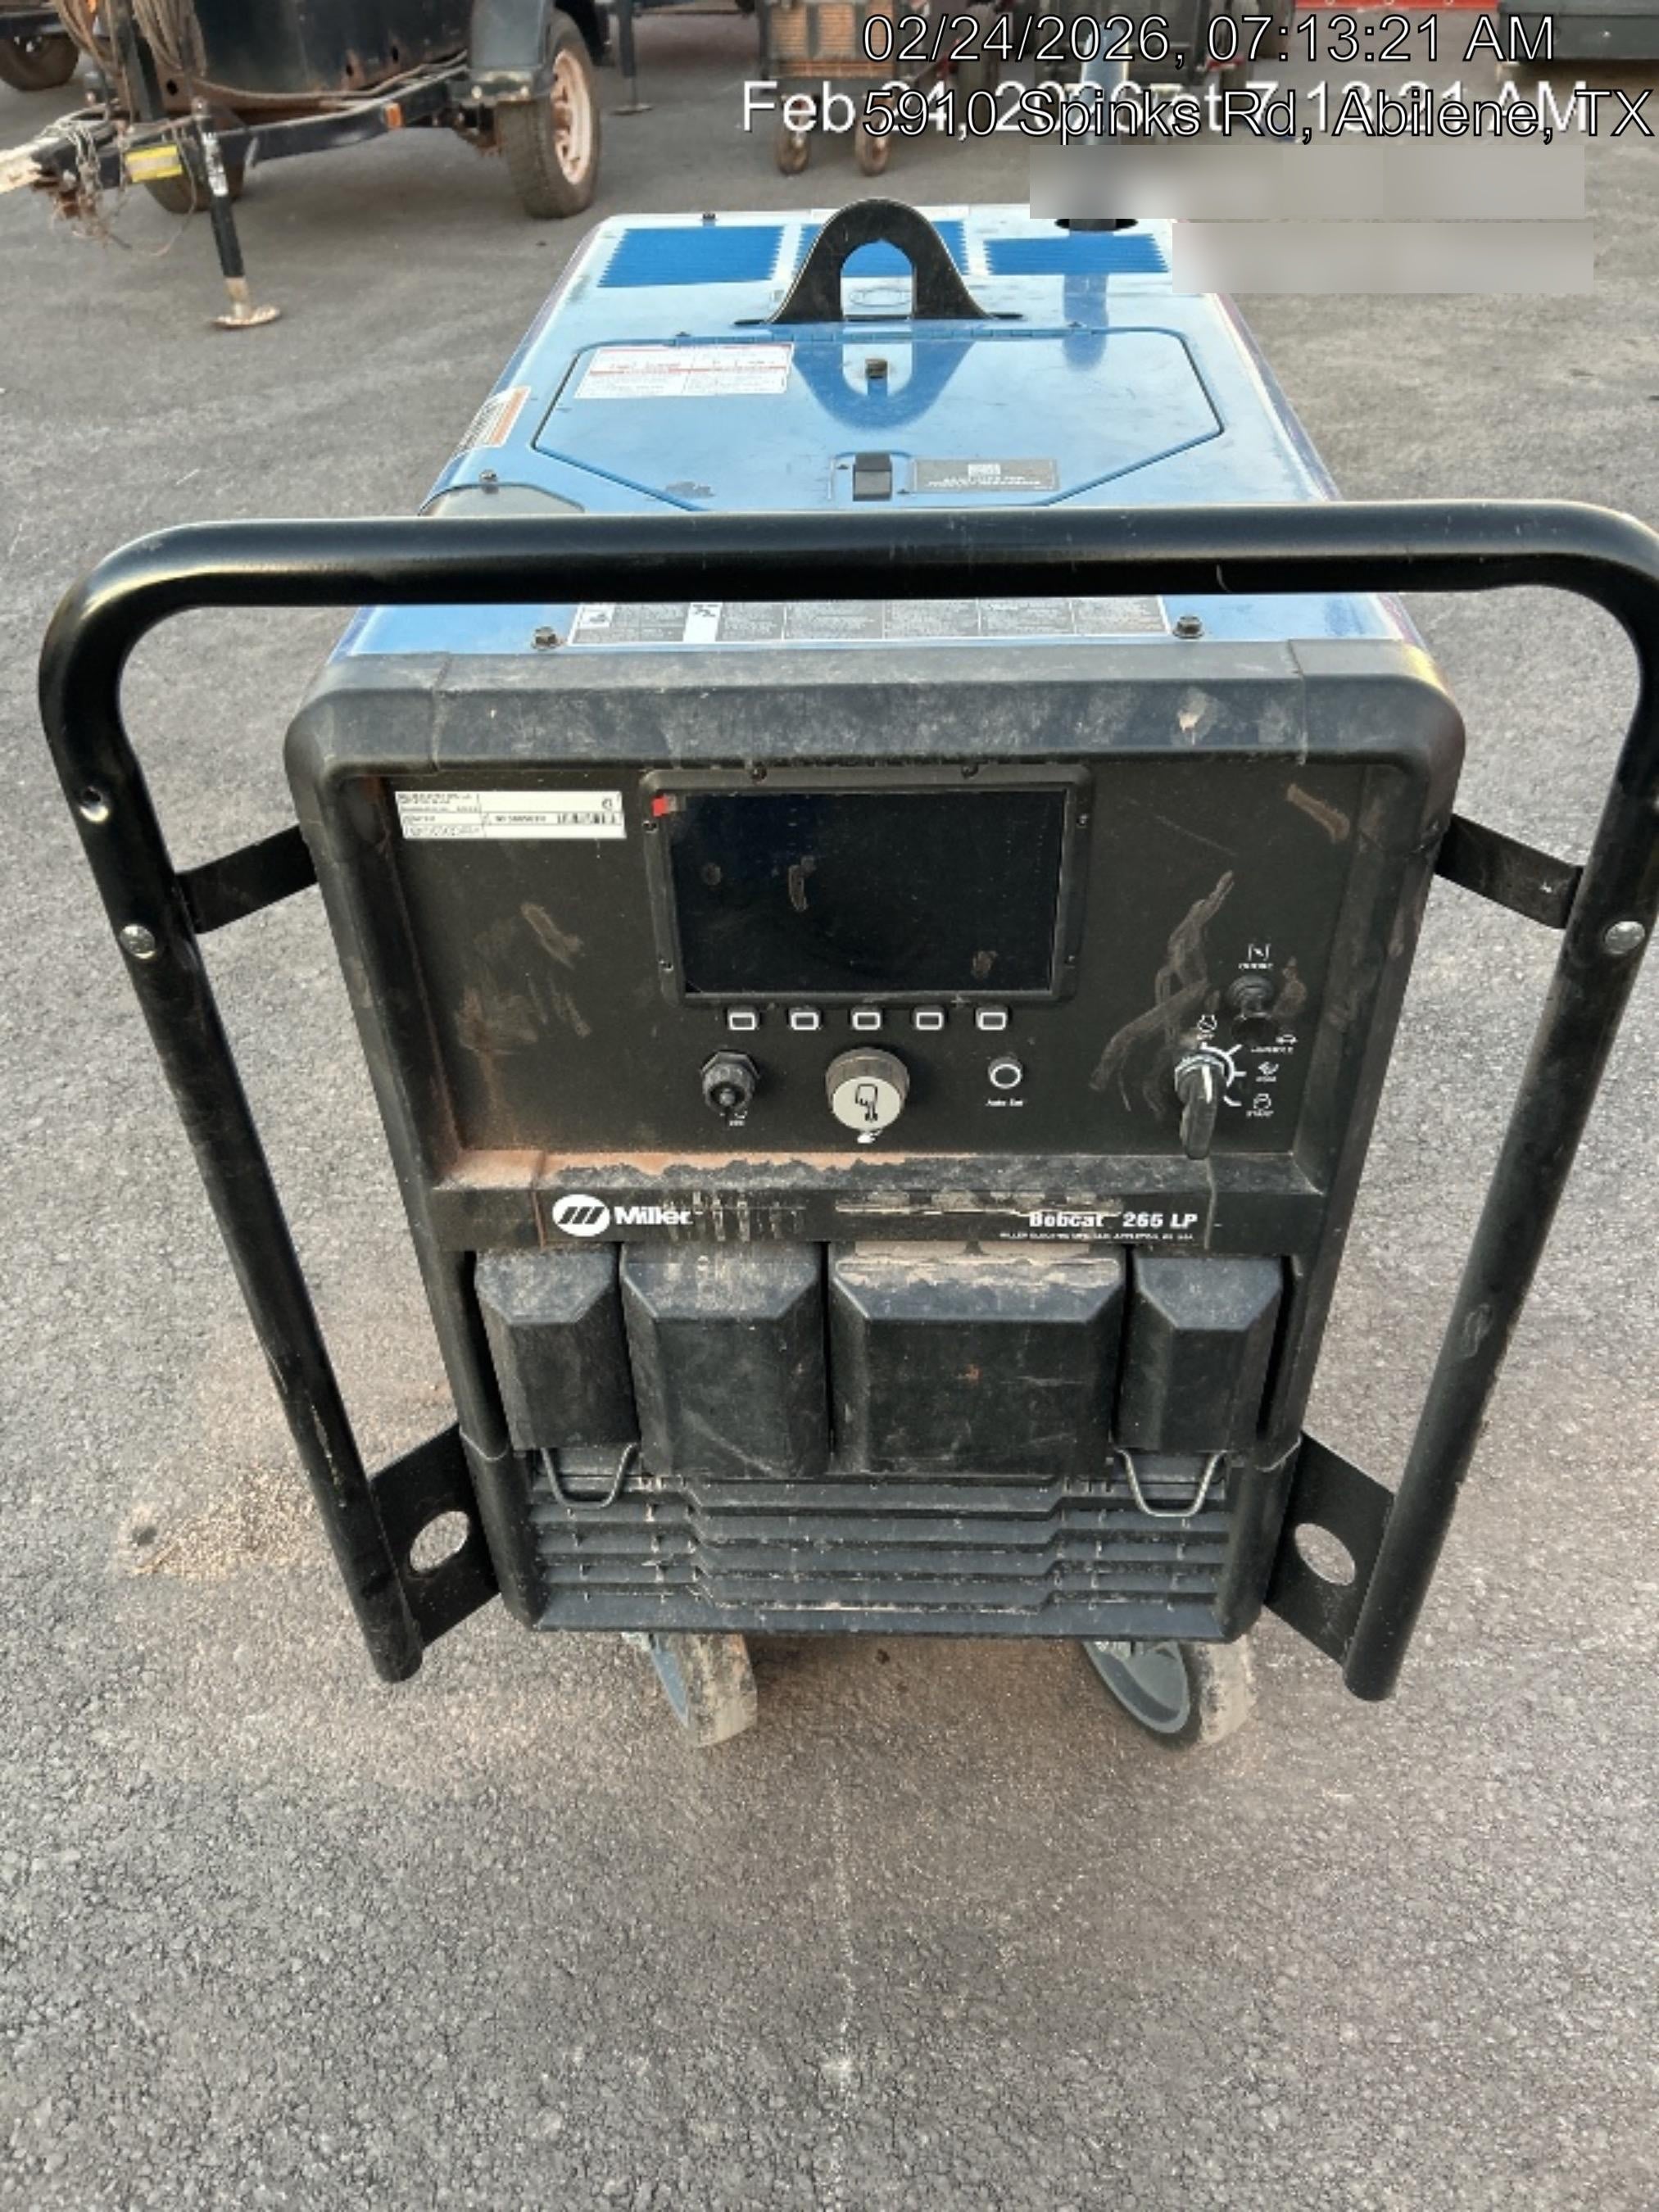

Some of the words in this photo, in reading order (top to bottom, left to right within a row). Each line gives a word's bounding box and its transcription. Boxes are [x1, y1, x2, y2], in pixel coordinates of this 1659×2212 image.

[614, 1205, 694, 1226] Miller
[1029, 1212, 1104, 1228] Bobcat
[1122, 1212, 1163, 1228] 265
[1170, 1213, 1199, 1228] LP
